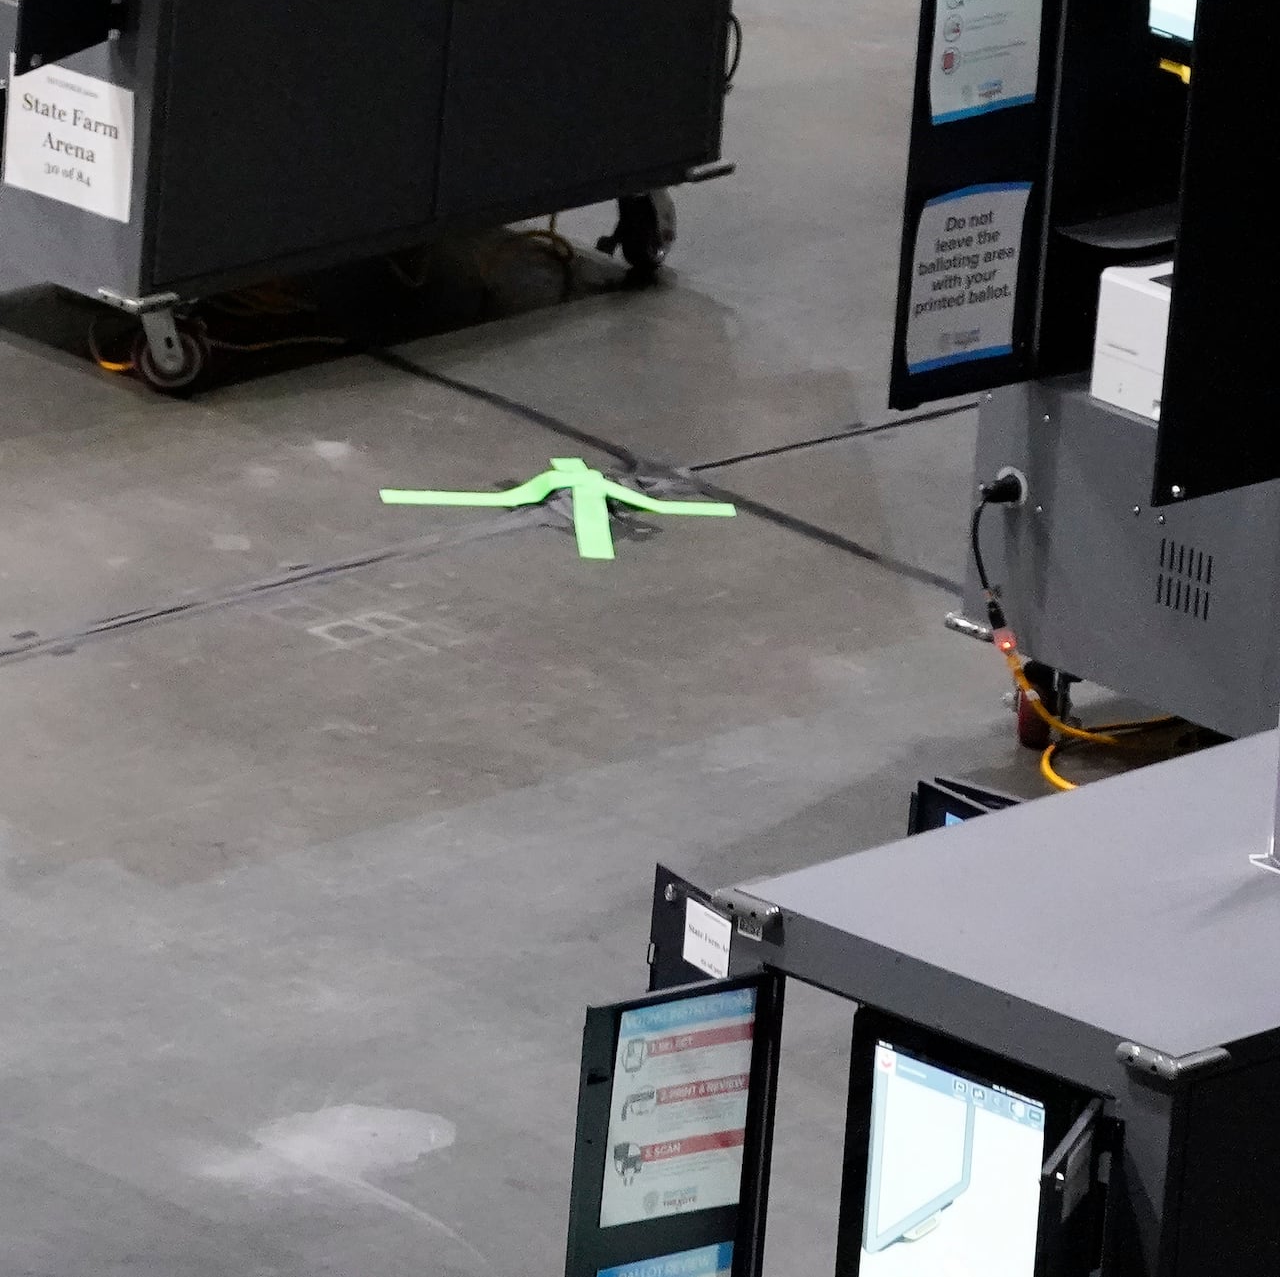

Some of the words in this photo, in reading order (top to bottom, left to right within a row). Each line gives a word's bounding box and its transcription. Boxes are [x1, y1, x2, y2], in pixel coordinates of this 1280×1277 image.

[23, 93, 65, 122] State
[73, 109, 119, 140] Farm
[43, 132, 95, 163] Arena
[62, 167, 75, 180] of
[945, 217, 965, 232] Do
[971, 211, 994, 226] not
[935, 235, 973, 253] leave
[978, 230, 1000, 245] the
[918, 252, 979, 276] balloting
[984, 246, 1014, 262] area
[932, 275, 961, 292] with
[965, 269, 998, 290] your
[914, 293, 965, 318] printed
